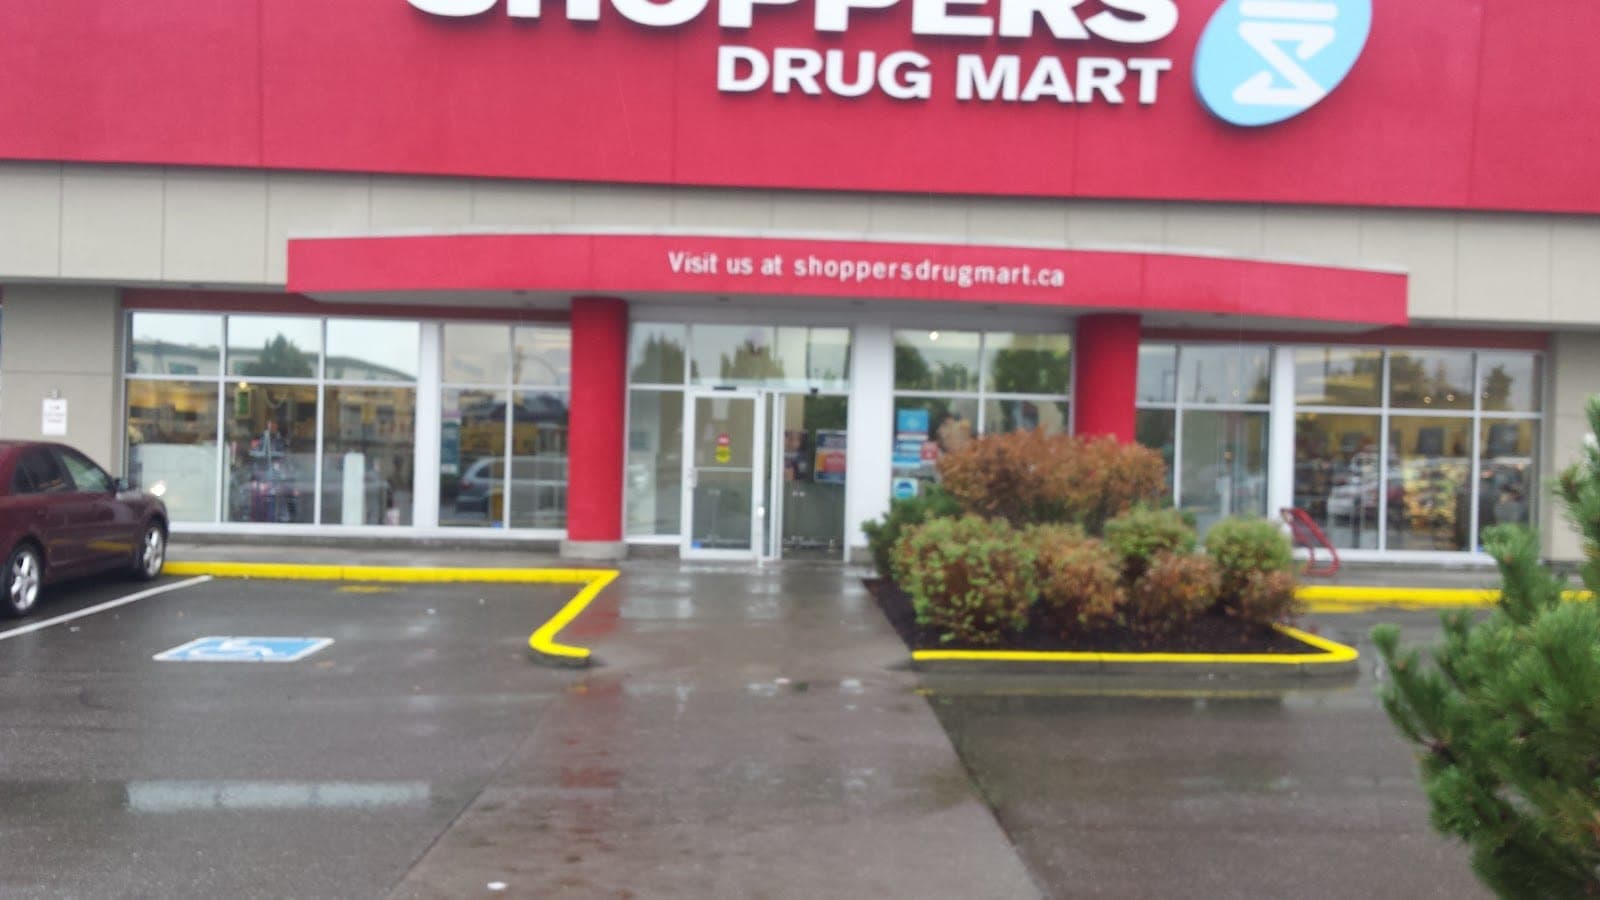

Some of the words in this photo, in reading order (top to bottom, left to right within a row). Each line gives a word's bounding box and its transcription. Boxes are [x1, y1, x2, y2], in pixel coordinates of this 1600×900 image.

[717, 45, 932, 99] DRUG
[956, 54, 1172, 104] MART
[668, 251, 719, 274] Visit
[726, 257, 753, 275] us
[760, 255, 783, 276] at
[794, 255, 1065, 288] shoppersdrugmart.ca
